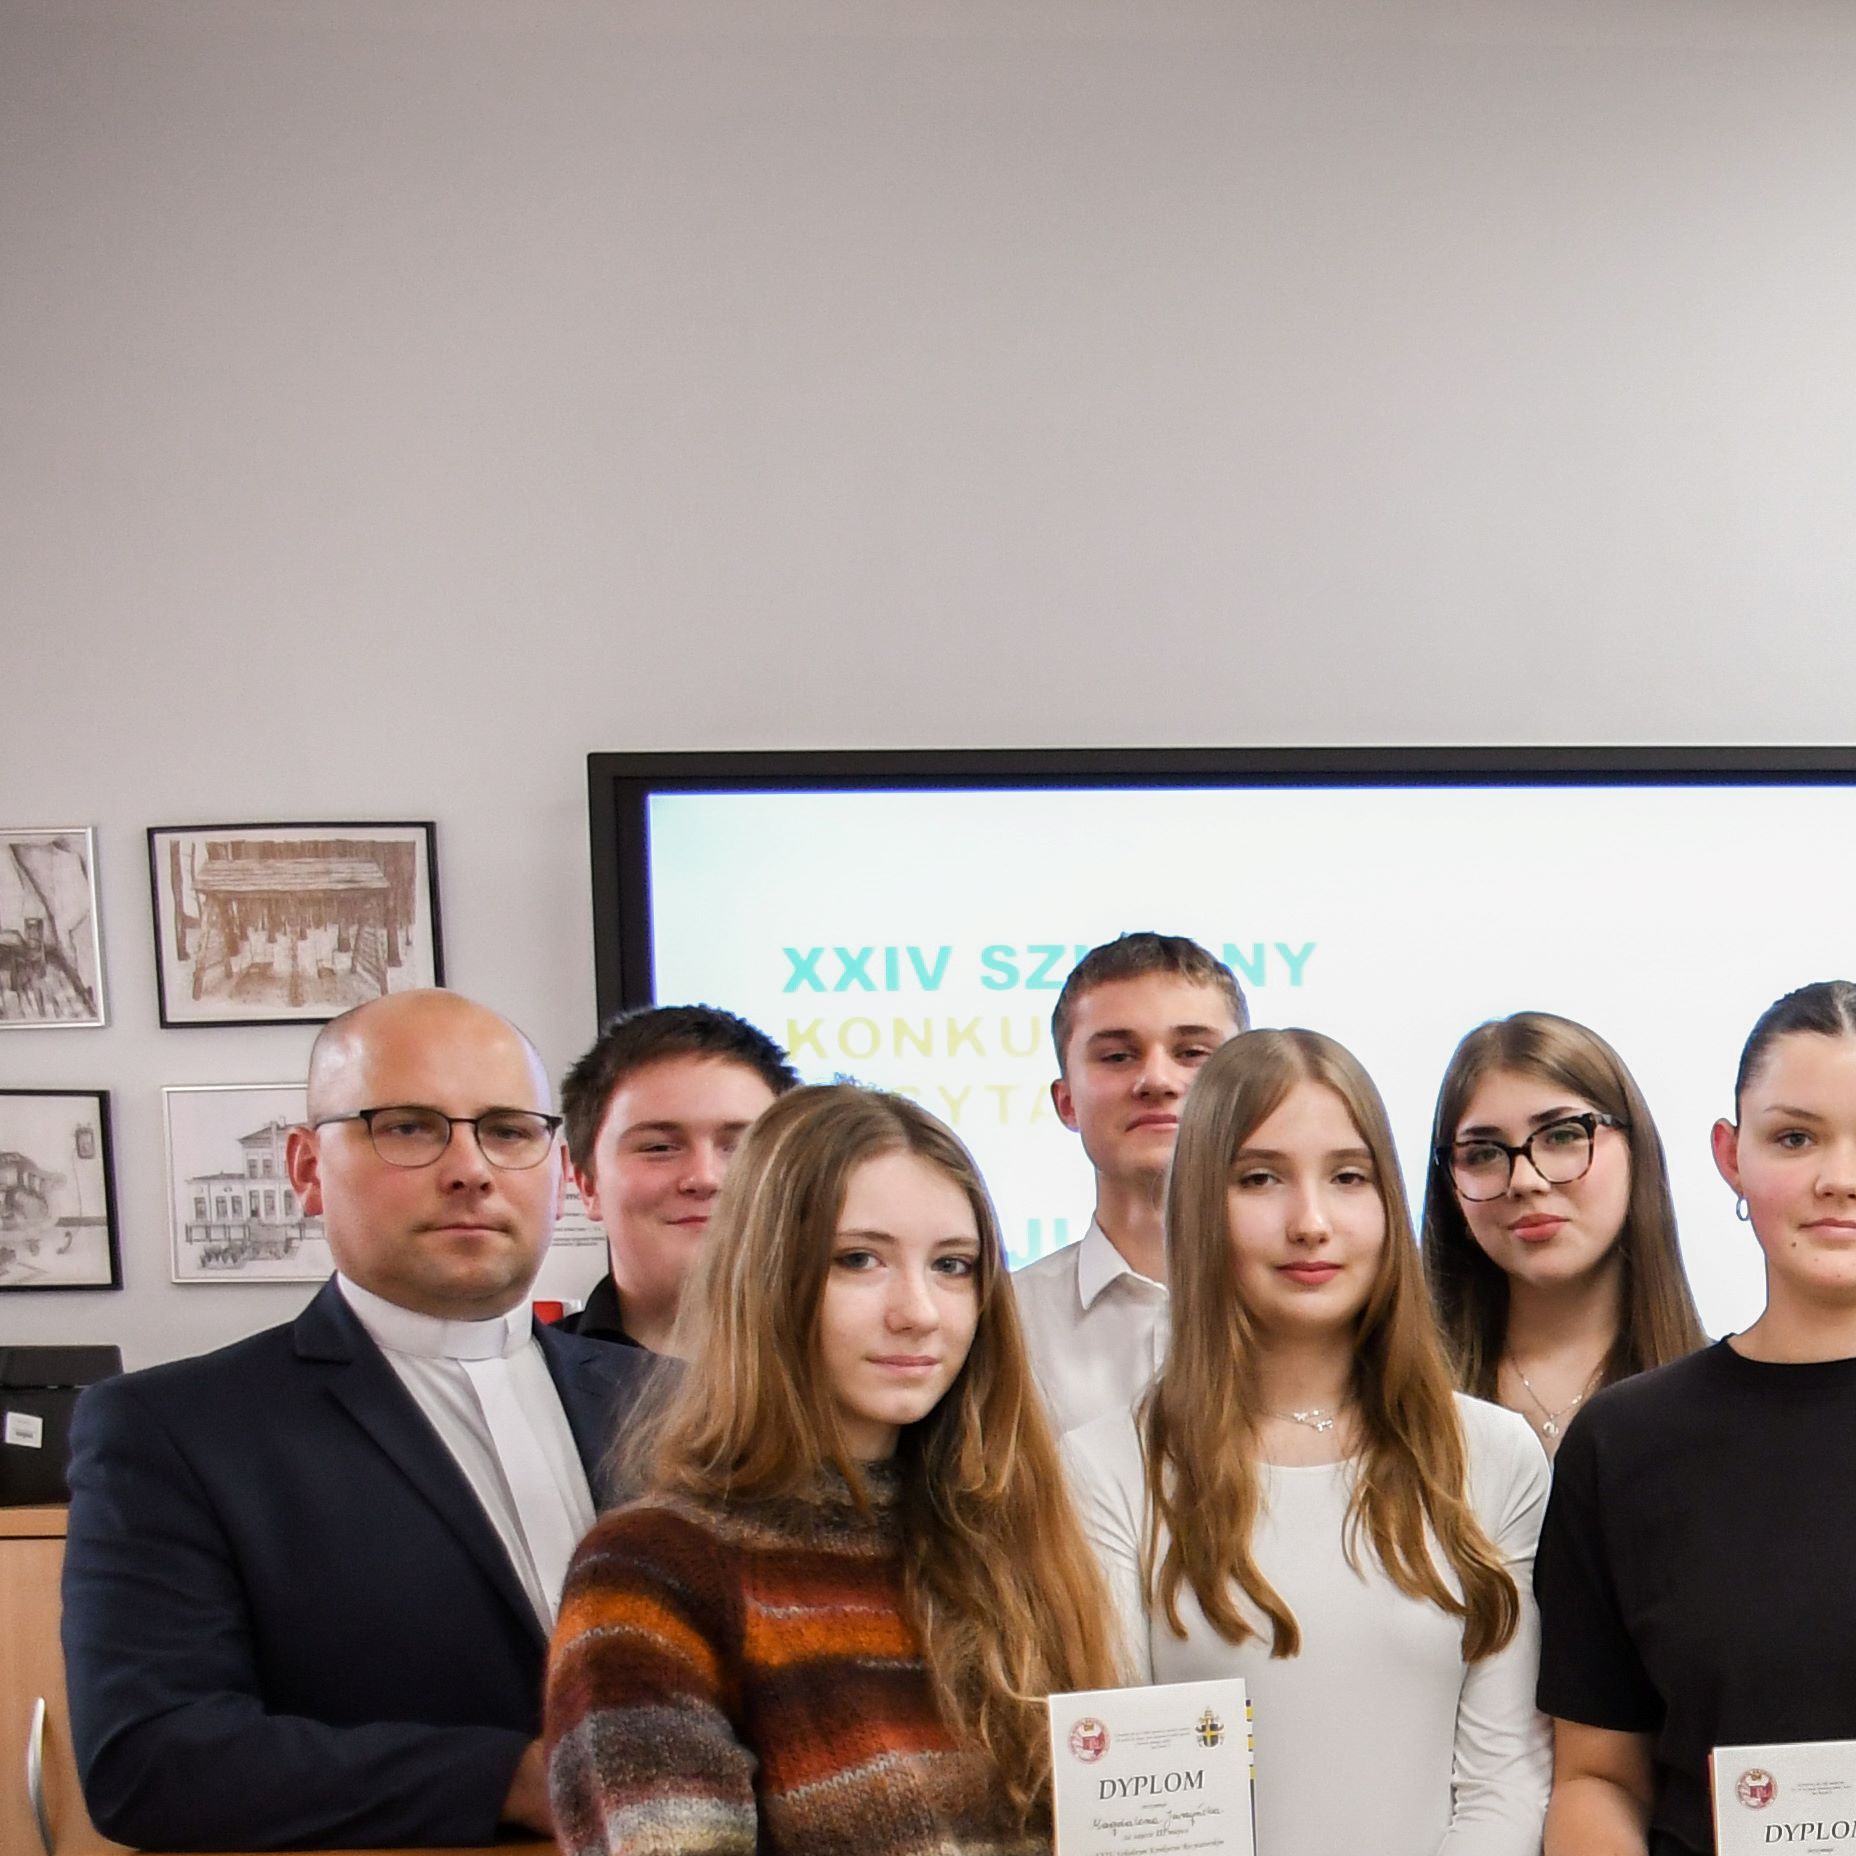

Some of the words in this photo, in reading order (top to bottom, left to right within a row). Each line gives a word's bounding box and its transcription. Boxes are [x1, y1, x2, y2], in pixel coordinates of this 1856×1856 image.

[783, 945, 952, 992] XXIV
[980, 943, 1317, 990] SZNY
[786, 1016, 1041, 1060] KONKU
[1099, 1769, 1204, 1800] DYPLOM
